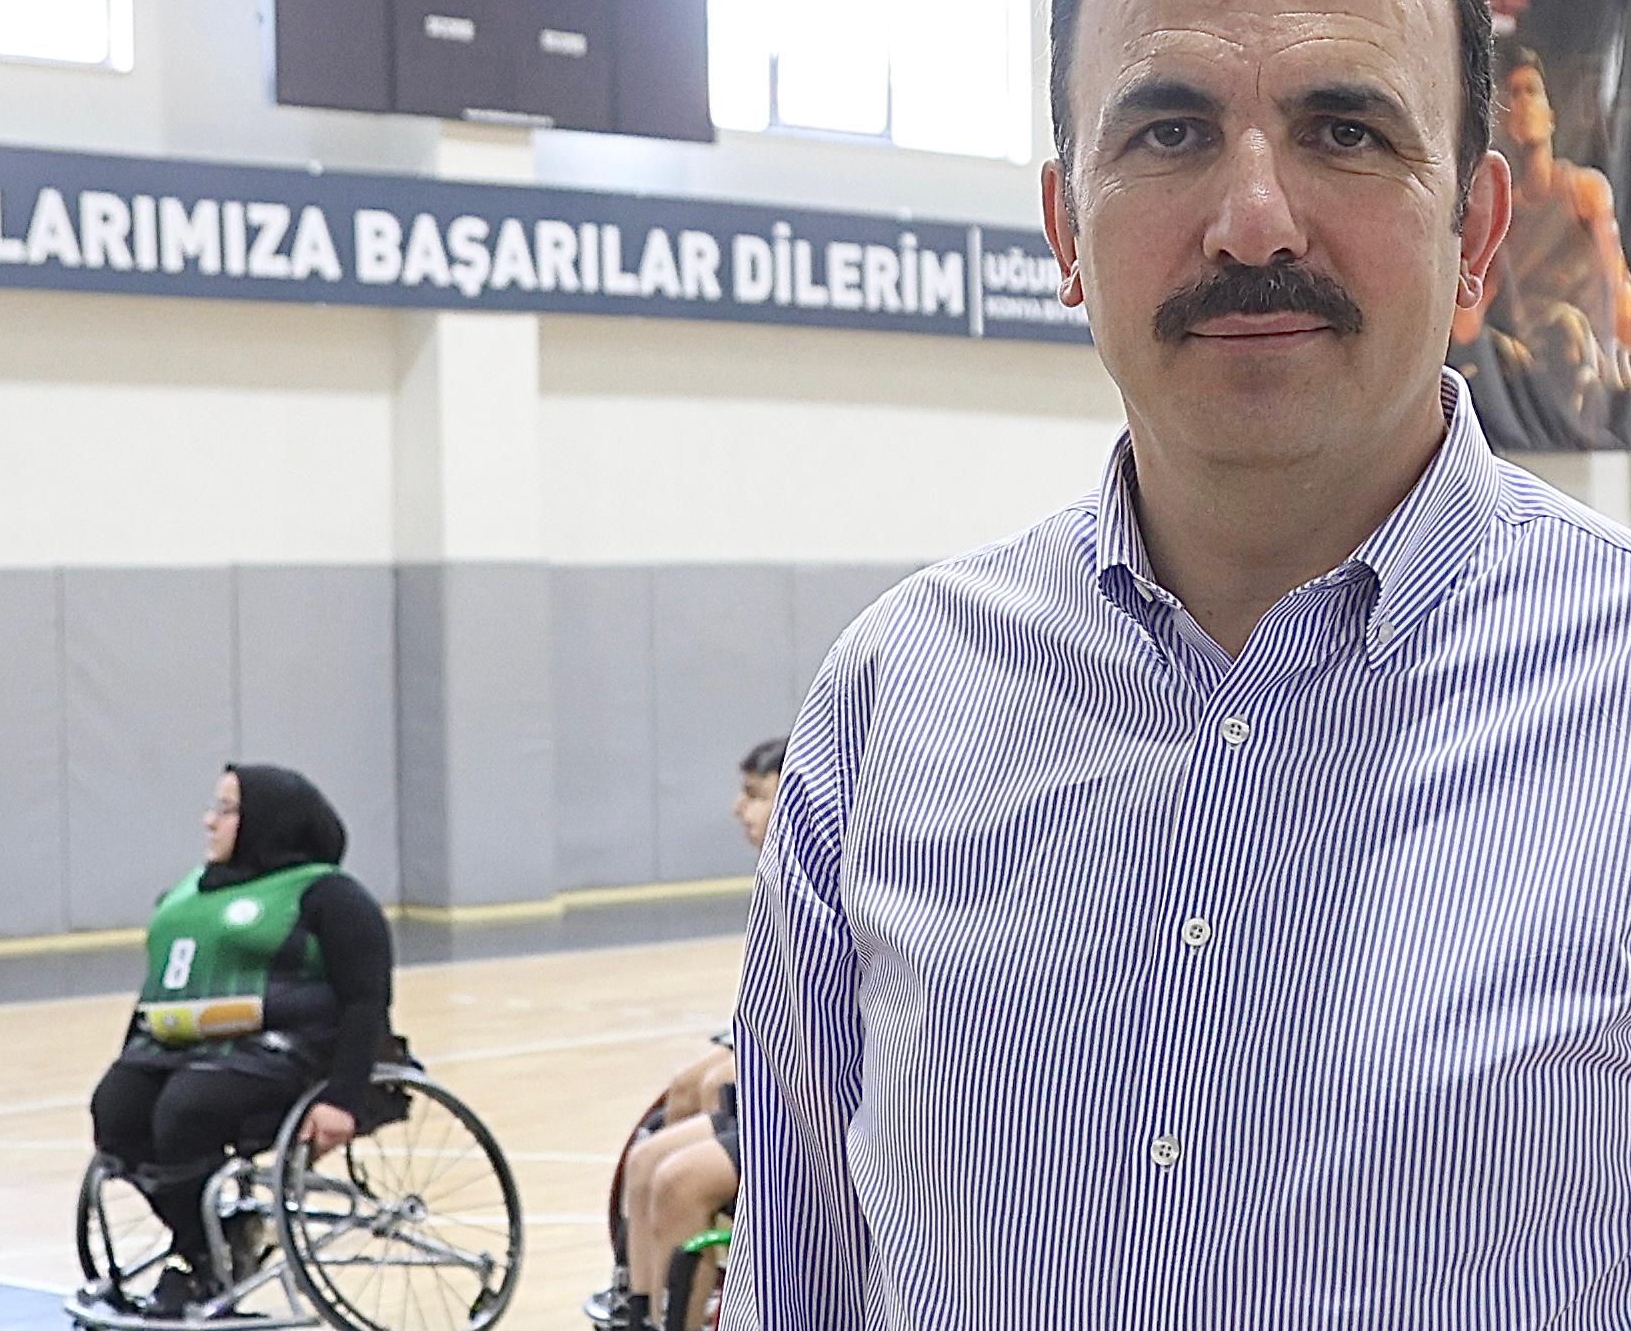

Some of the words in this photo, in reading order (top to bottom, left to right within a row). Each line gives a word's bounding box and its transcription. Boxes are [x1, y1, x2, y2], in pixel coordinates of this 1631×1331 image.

[354, 208, 723, 301] BAŞARILAR
[732, 220, 965, 317] DİLERİM
[162, 937, 196, 990] 8
